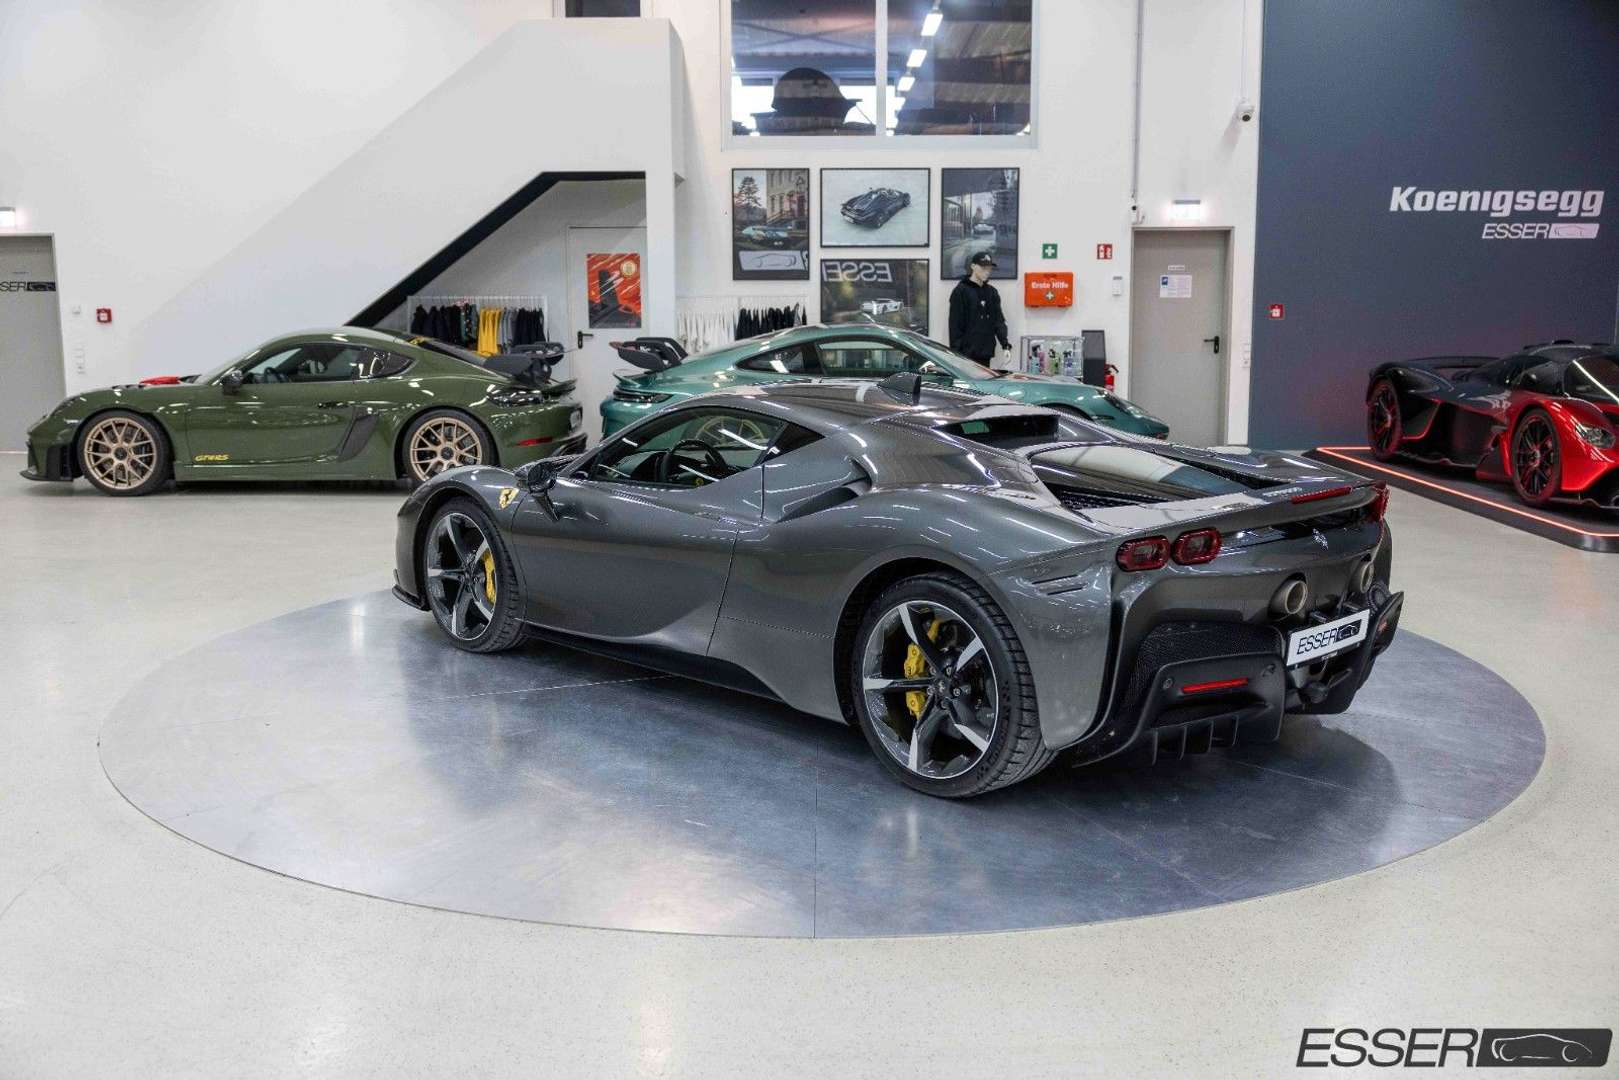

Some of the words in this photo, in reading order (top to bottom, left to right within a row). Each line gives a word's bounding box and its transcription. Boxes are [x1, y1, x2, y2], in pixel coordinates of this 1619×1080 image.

[1389, 186, 1604, 217] Koenigsegg
[1482, 223, 1550, 239] ESSER
[0, 281, 27, 291] SER
[1296, 627, 1338, 655] ESSER
